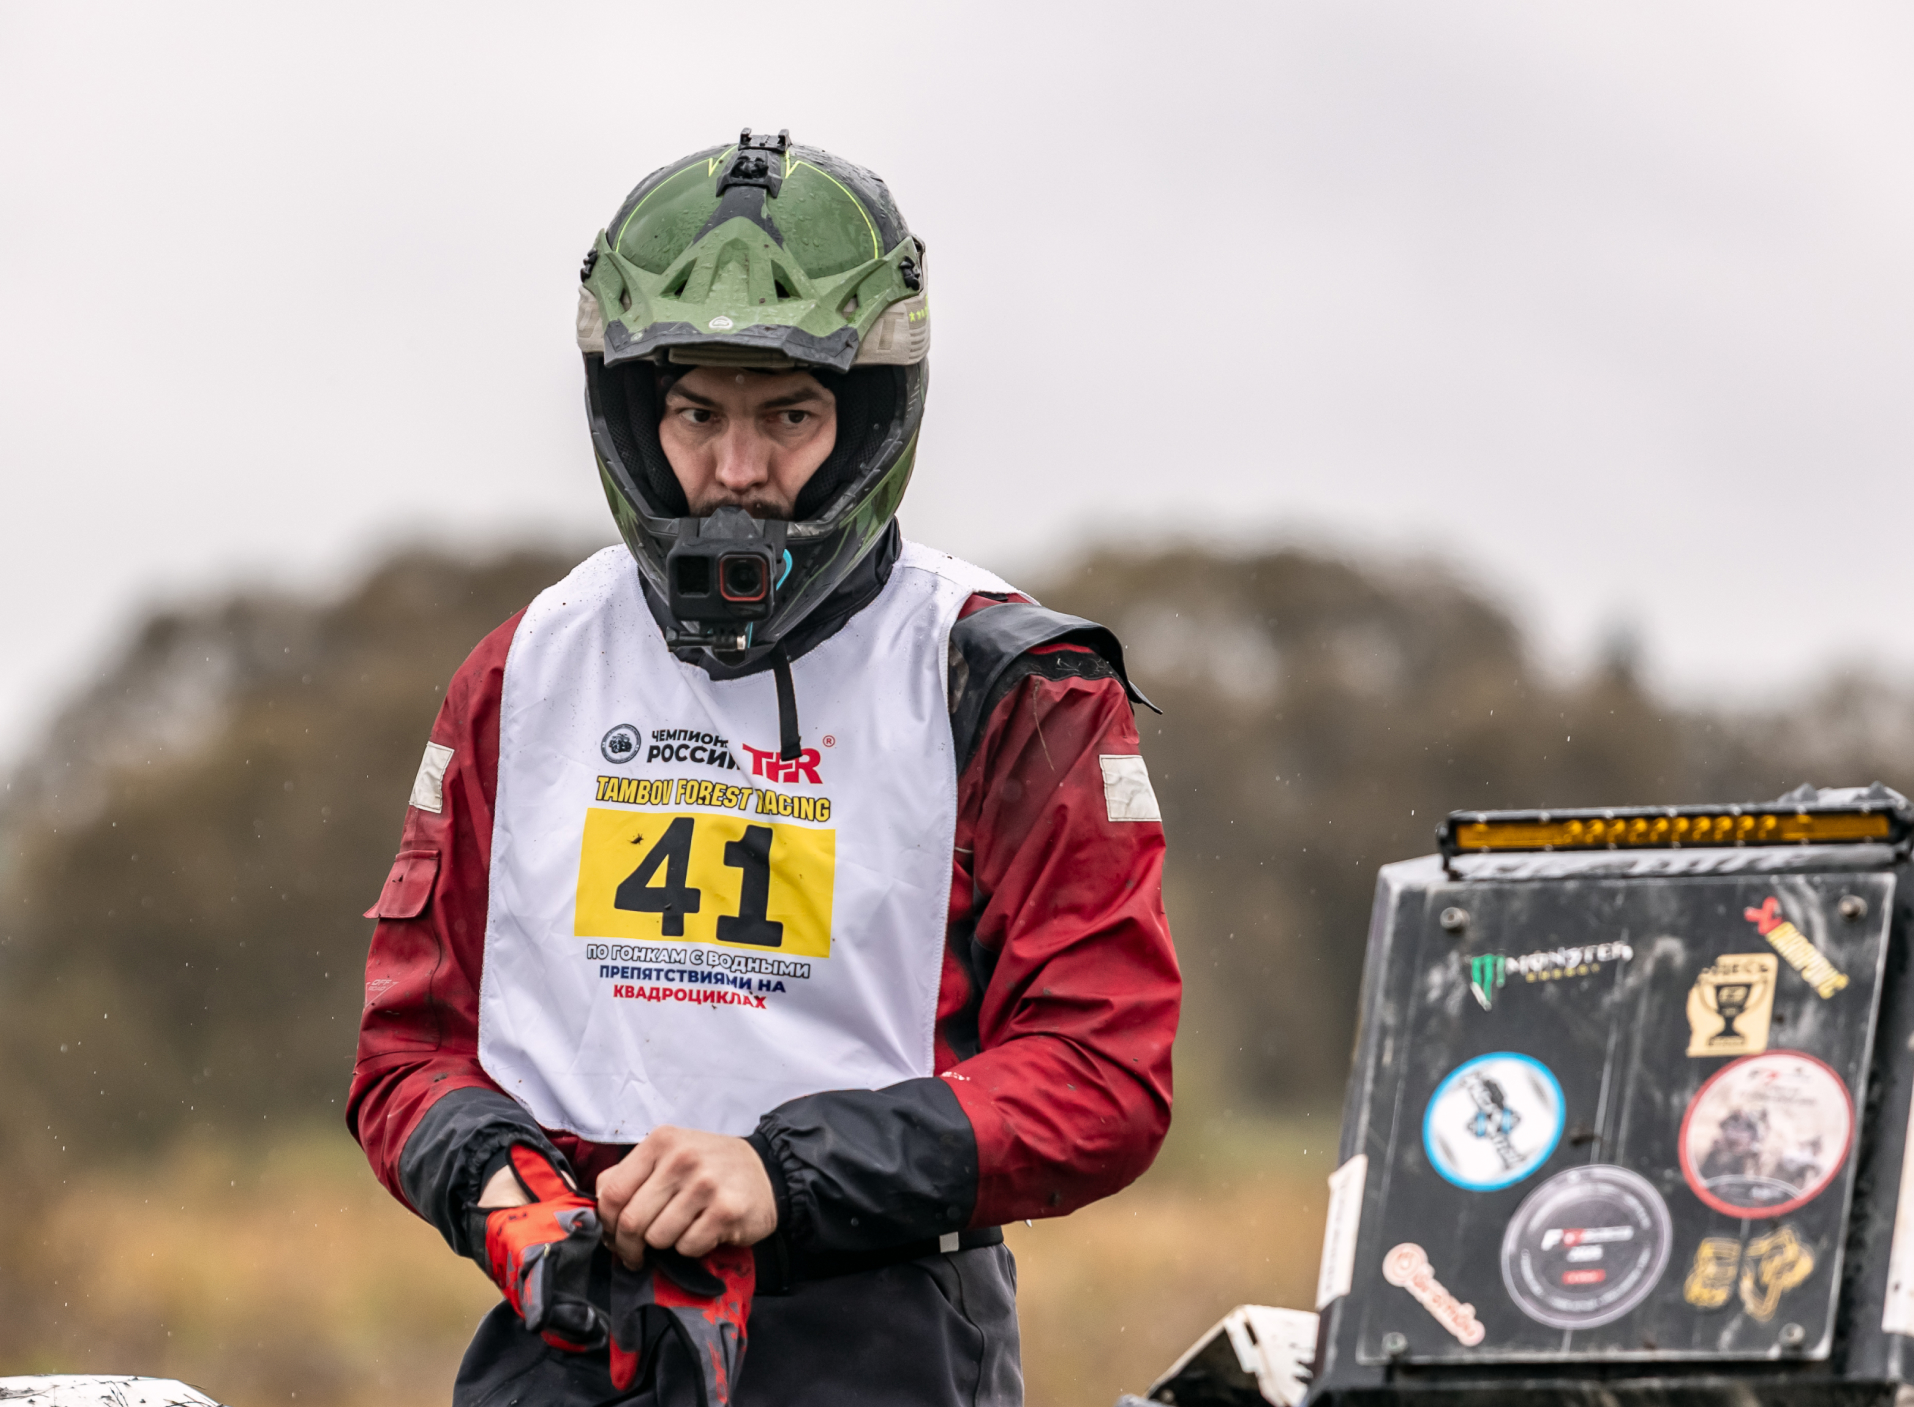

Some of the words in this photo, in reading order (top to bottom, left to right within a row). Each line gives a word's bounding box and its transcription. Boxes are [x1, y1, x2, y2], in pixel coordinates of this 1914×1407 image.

[652, 729, 728, 748] ЧЕМПИОН
[596, 775, 674, 806] TAMBOV
[675, 778, 753, 811] FOREST
[614, 816, 783, 947] 41
[587, 944, 609, 960] ПО
[611, 945, 687, 965] ГОНКАМ
[690, 949, 704, 966] С
[706, 950, 811, 979] ВОДНЫМИ
[600, 965, 752, 990] ПРЕПЯТСТВИЯМИ
[758, 979, 786, 993] НА
[613, 984, 766, 1009] КВАДРОЦИКЛАХ
